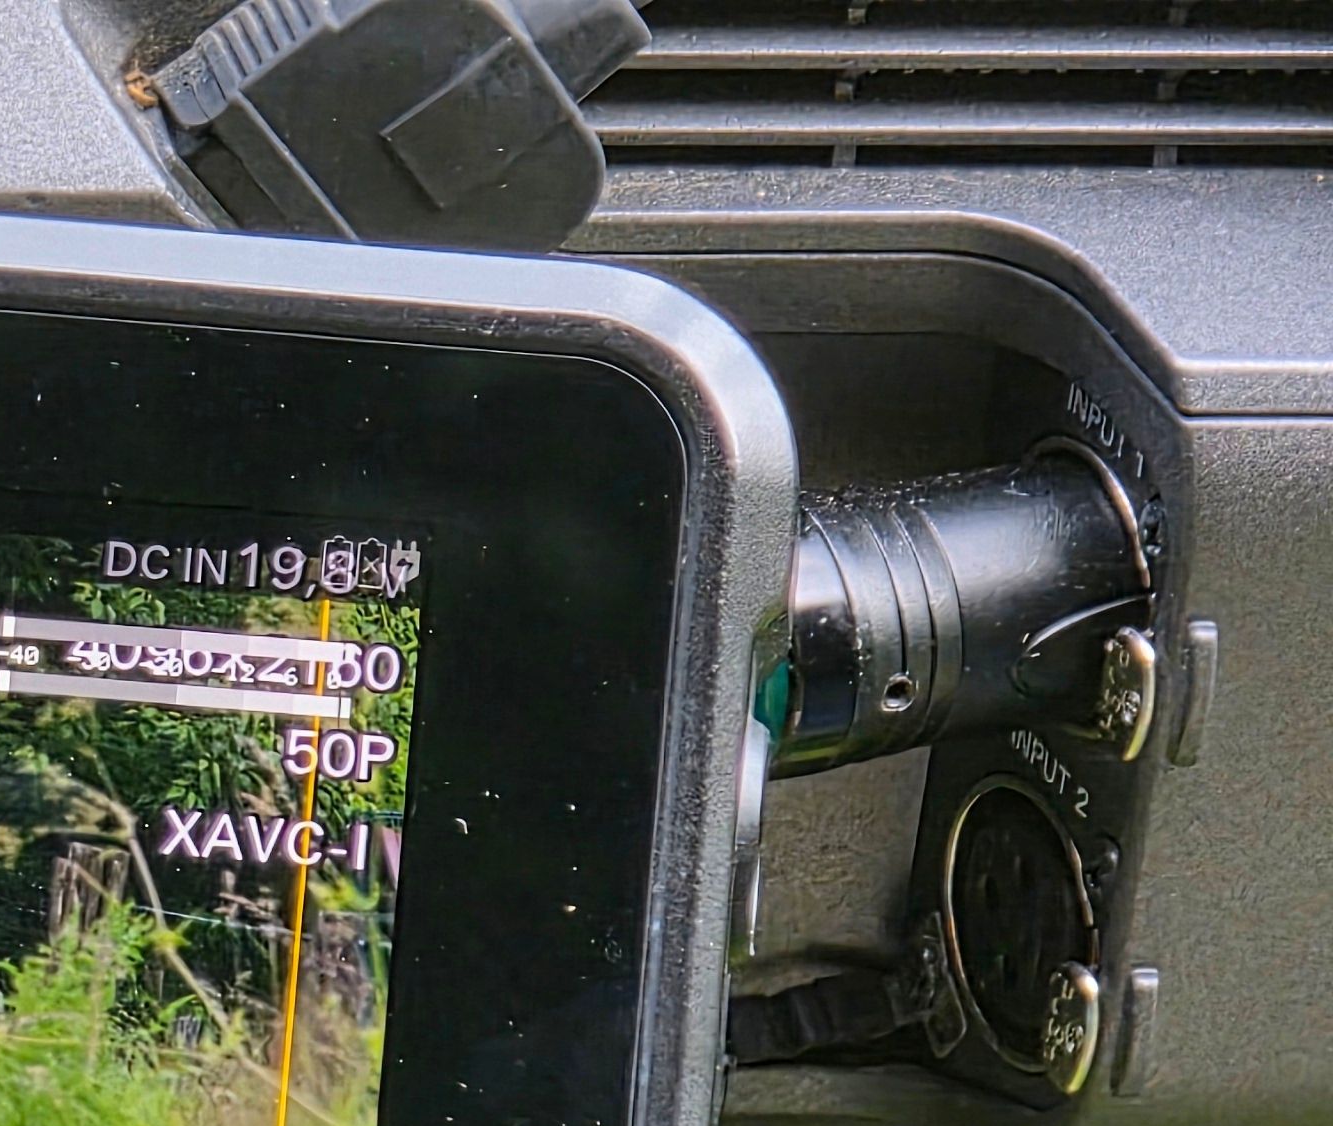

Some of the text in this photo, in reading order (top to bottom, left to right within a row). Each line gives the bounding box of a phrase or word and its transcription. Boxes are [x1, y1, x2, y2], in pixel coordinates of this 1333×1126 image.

[105, 539, 170, 580] DC
[183, 546, 227, 586] IN
[282, 729, 397, 782] 50P
[1011, 729, 1091, 821] INPUT 2
